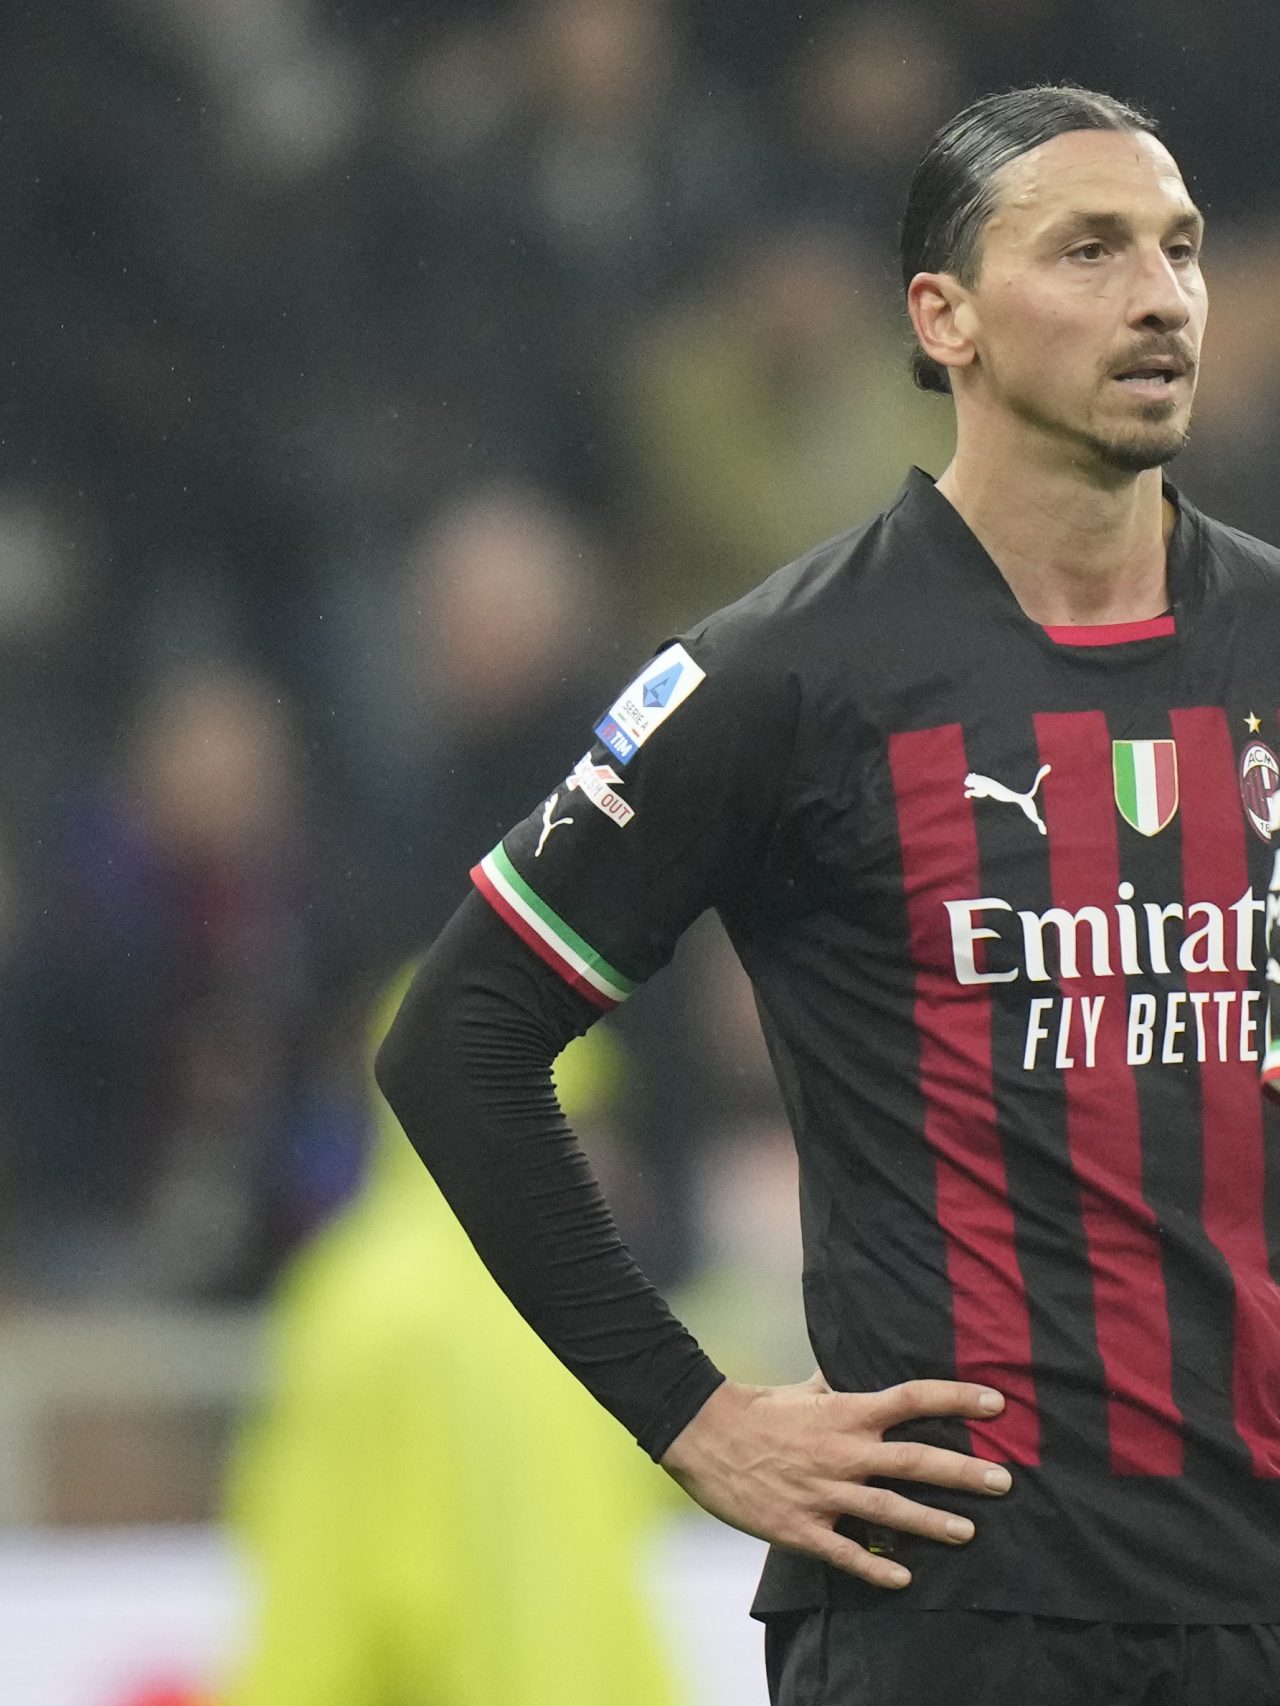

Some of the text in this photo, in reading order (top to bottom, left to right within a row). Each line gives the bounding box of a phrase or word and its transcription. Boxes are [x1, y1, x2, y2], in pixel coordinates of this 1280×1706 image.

[622, 700, 643, 726] SERIE
[610, 730, 633, 757] TIM
[1248, 749, 1275, 768] ACM
[601, 793, 631, 820] OUT
[943, 881, 1270, 985] Emirat
[1023, 990, 1270, 1070] FLY BETTE
